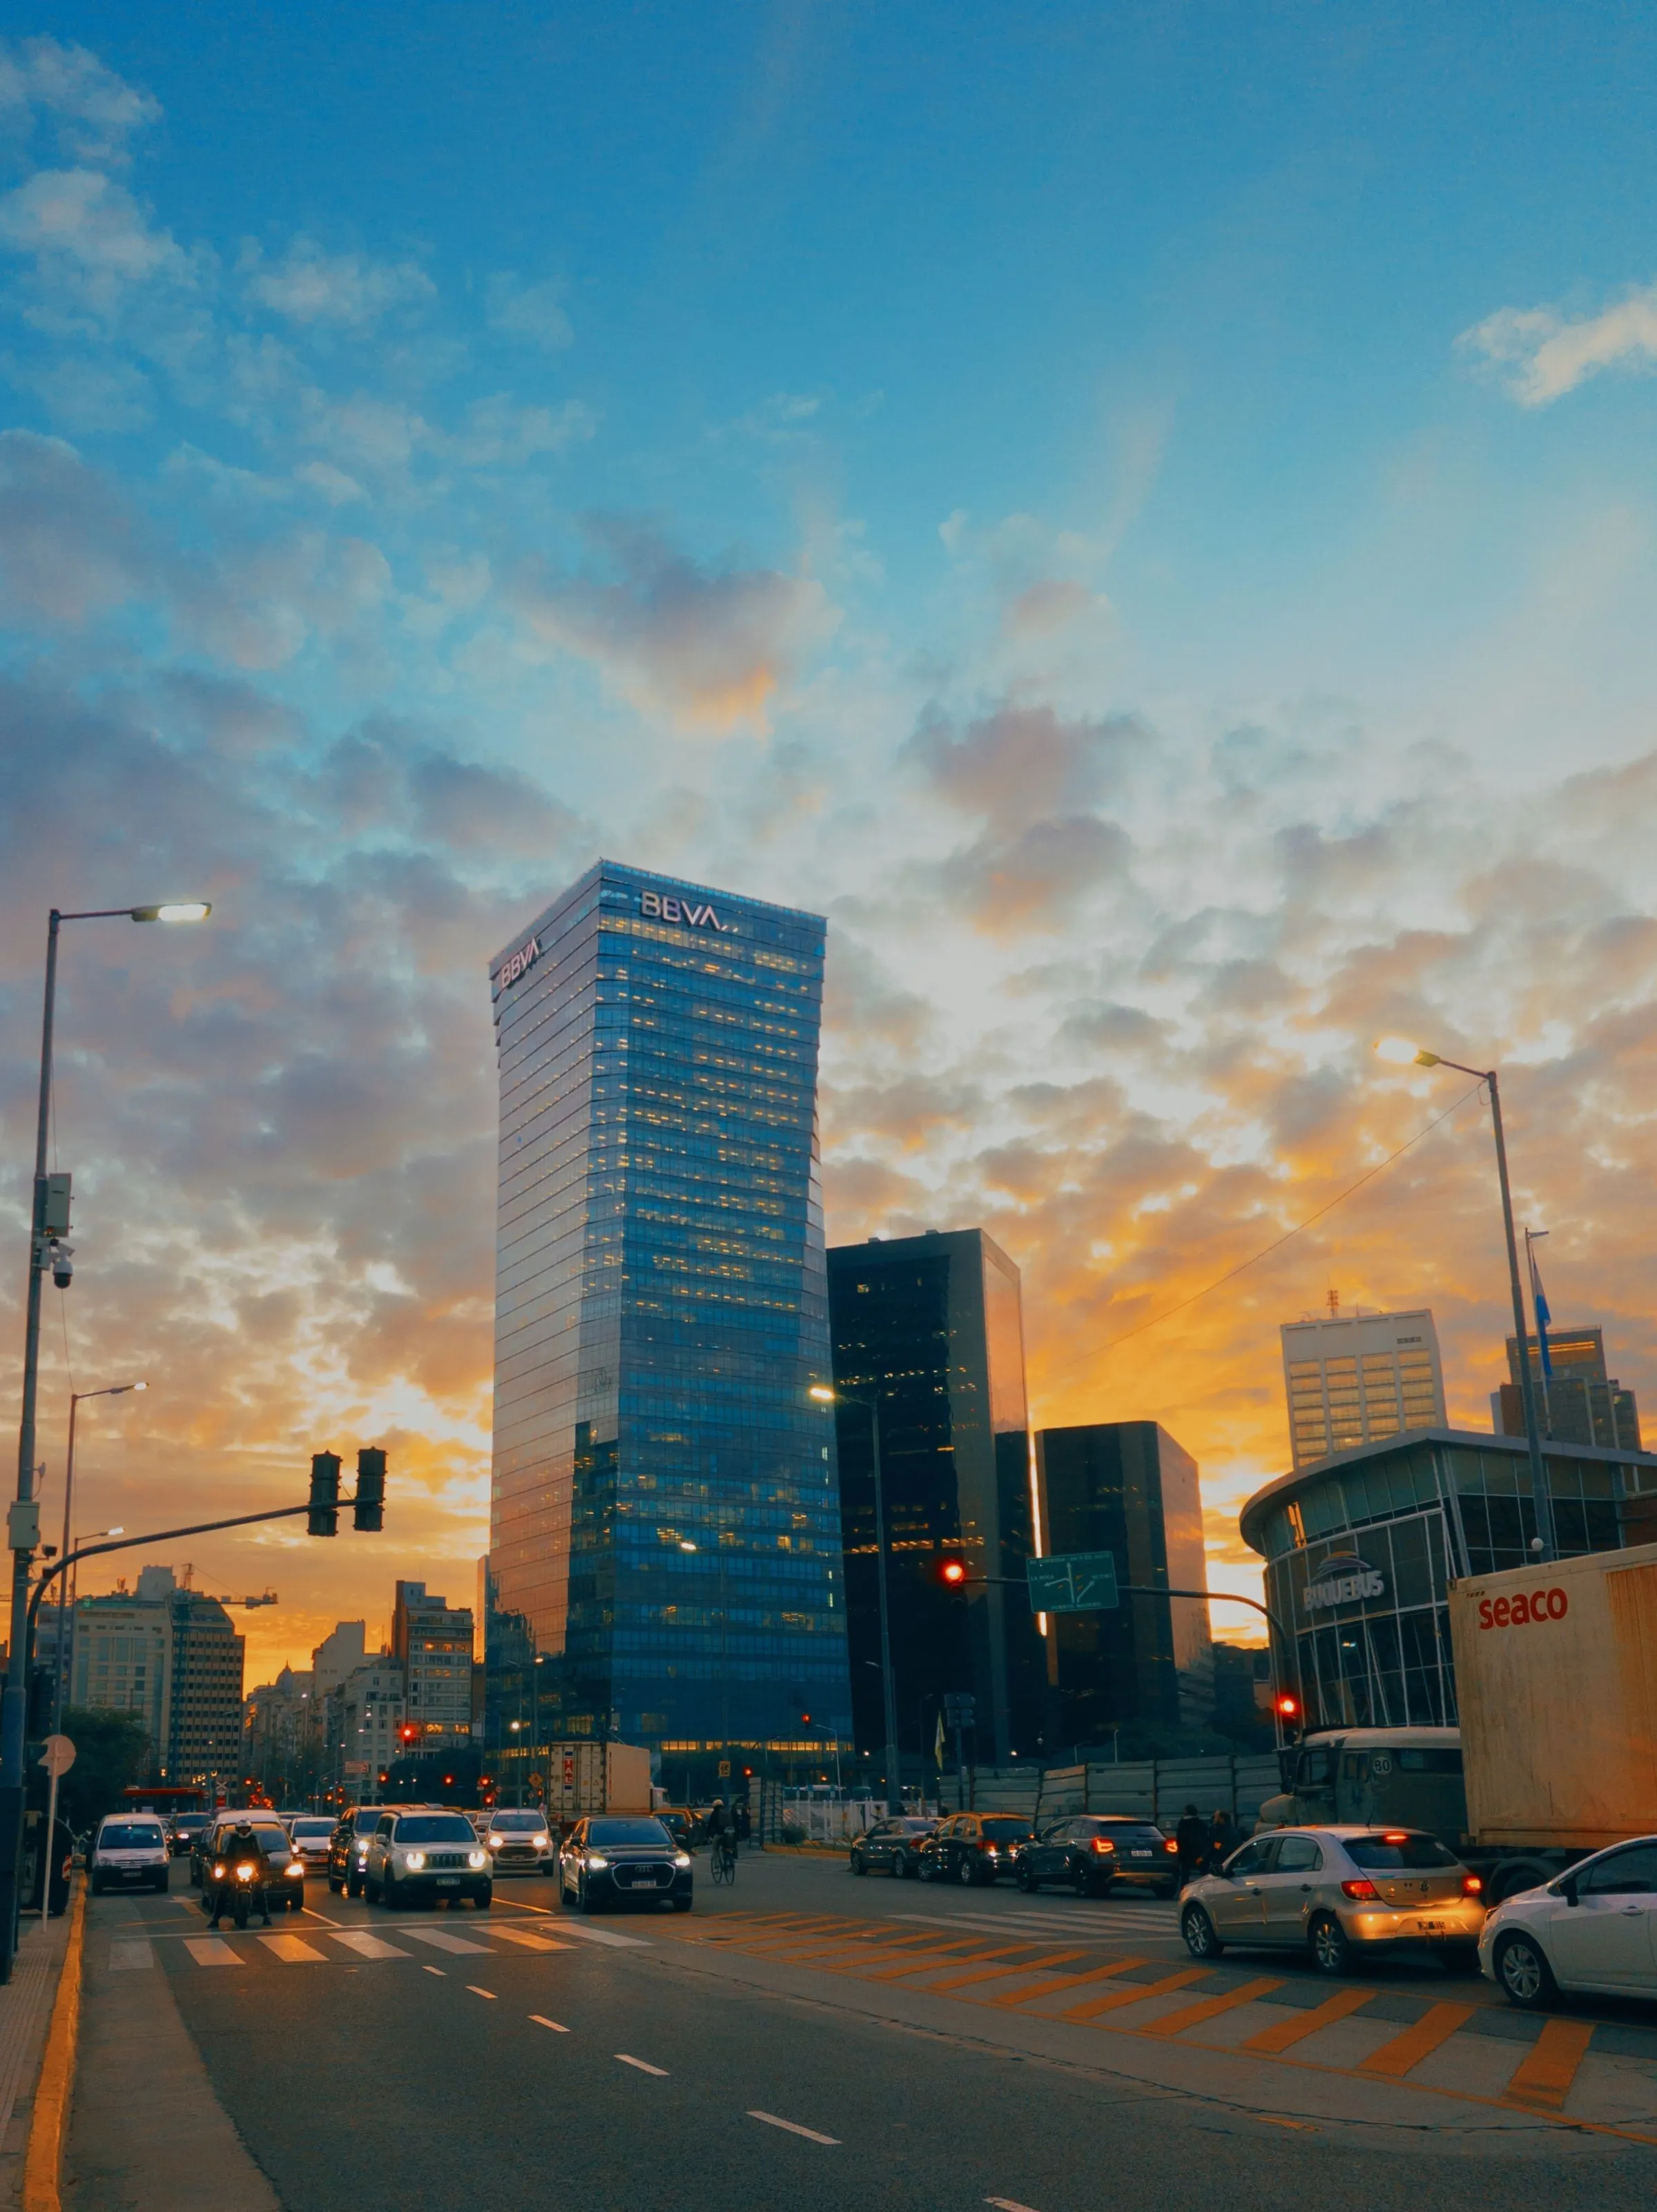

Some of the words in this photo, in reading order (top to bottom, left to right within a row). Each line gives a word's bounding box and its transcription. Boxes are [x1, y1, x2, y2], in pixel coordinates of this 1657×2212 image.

[641, 891, 721, 930] BBVA
[501, 938, 541, 989] BBVA
[1303, 1570, 1384, 1611] BUQUEBUS
[1479, 1587, 1568, 1630] seaco
[1375, 1760, 1390, 1772] 80
